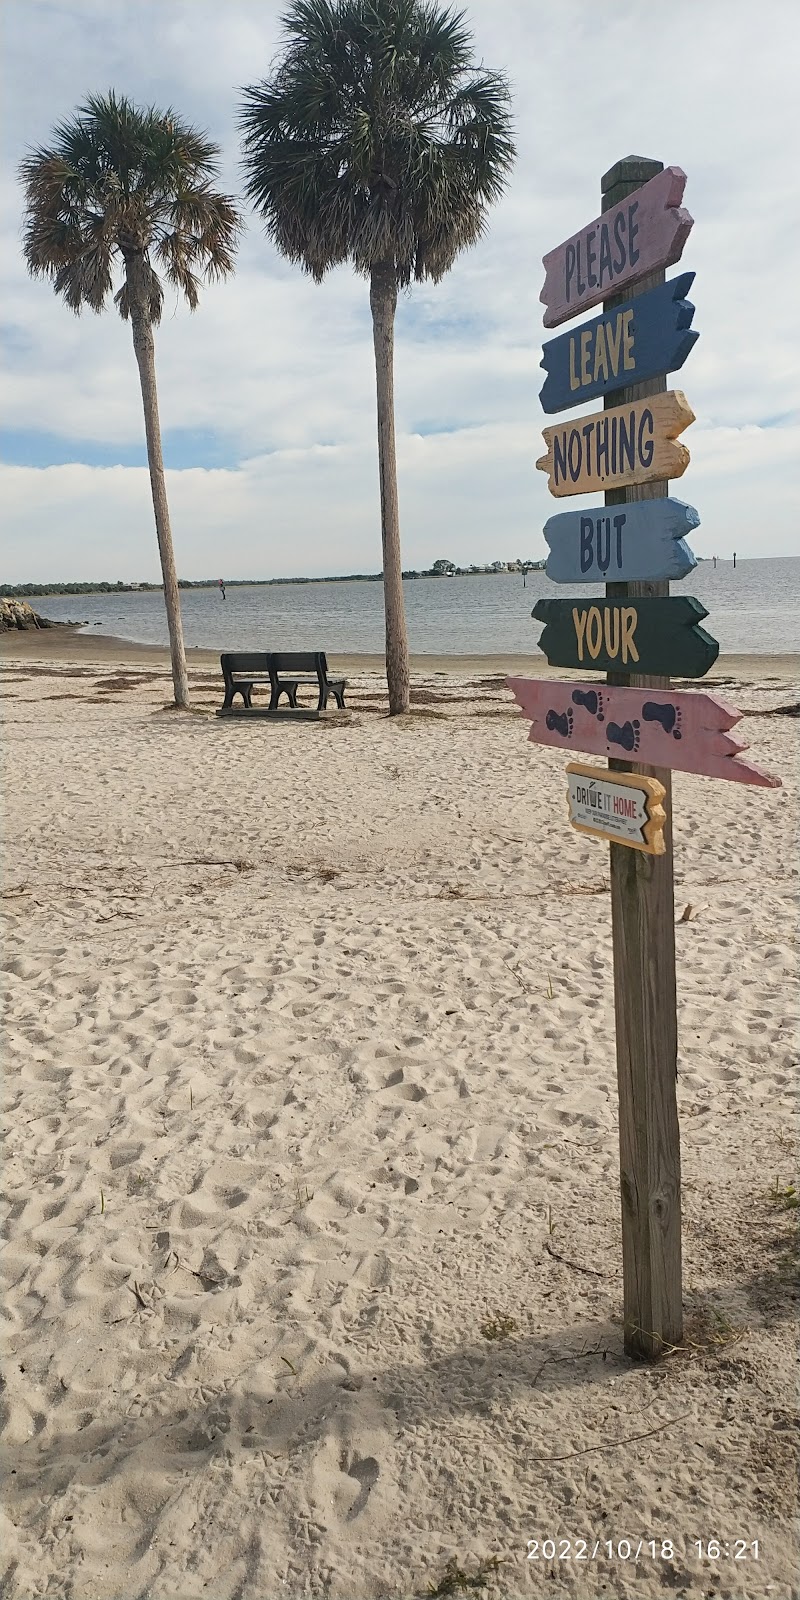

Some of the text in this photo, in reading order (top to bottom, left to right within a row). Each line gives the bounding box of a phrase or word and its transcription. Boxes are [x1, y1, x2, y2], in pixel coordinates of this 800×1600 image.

[564, 200, 640, 304] PLEASE
[569, 308, 636, 391] LEAVE
[553, 408, 654, 486] NOTHING
[580, 513, 627, 573] BUT
[572, 606, 639, 664] YOUR
[603, 795, 611, 812] IT
[613, 796, 637, 819] HOME
